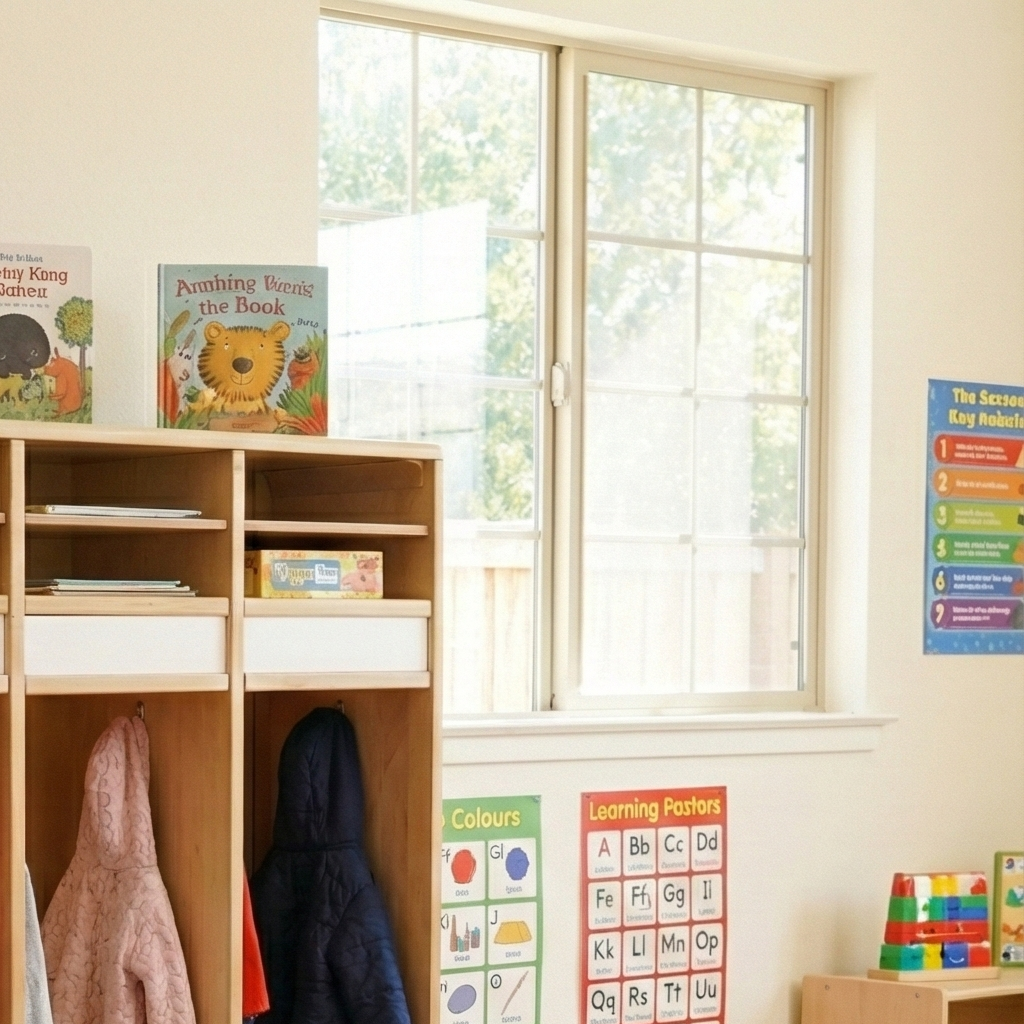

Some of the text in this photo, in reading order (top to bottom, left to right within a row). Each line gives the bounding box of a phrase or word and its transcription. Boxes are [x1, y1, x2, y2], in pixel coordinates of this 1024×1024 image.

[199, 296, 285, 315] the Book
[940, 439, 947, 458] 1
[938, 471, 948, 492] 2
[451, 806, 521, 830] Colours
[589, 797, 659, 823] Learning
[598, 829, 718, 857] A Bb Cc Dd
[663, 883, 685, 908] Gg
[490, 910, 498, 925] J
[594, 930, 719, 960] Kk Ll Mn Op
[591, 990, 615, 1015] Qq
[629, 986, 648, 1007] Rs
[664, 982, 682, 1003] Tt
[696, 978, 716, 999] Uu
